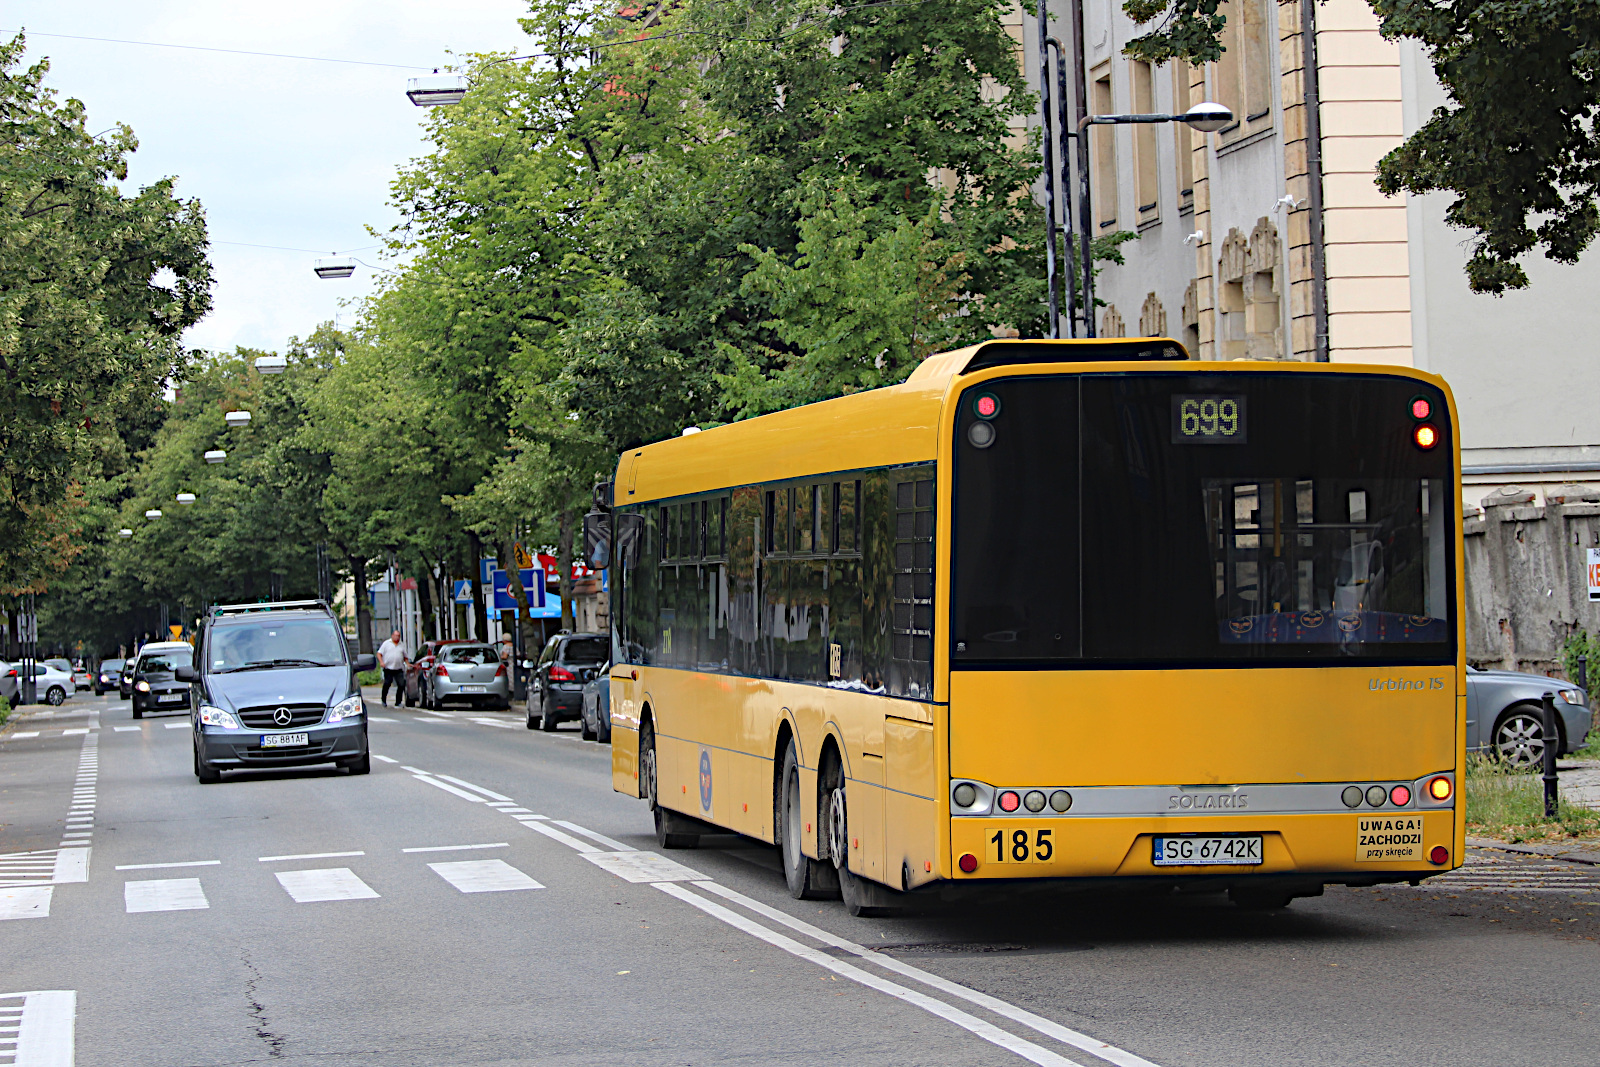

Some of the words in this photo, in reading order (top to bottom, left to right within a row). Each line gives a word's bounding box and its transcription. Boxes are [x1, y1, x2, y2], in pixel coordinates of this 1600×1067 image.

[1181, 399, 1238, 435] 699
[1368, 677, 1425, 691] Urbino
[1428, 677, 1445, 690] 15
[265, 735, 278, 745] SG
[280, 733, 306, 744] 881AF
[1168, 794, 1249, 810] SOLARIS
[1360, 819, 1421, 832] UWAGA!
[990, 829, 1053, 862] 185
[1359, 833, 1421, 846] ZACHODZI
[1166, 840, 1193, 859] SG
[1200, 839, 1258, 859] 6742K
[1366, 849, 1384, 859] przy
[1385, 846, 1413, 858] skręcie
